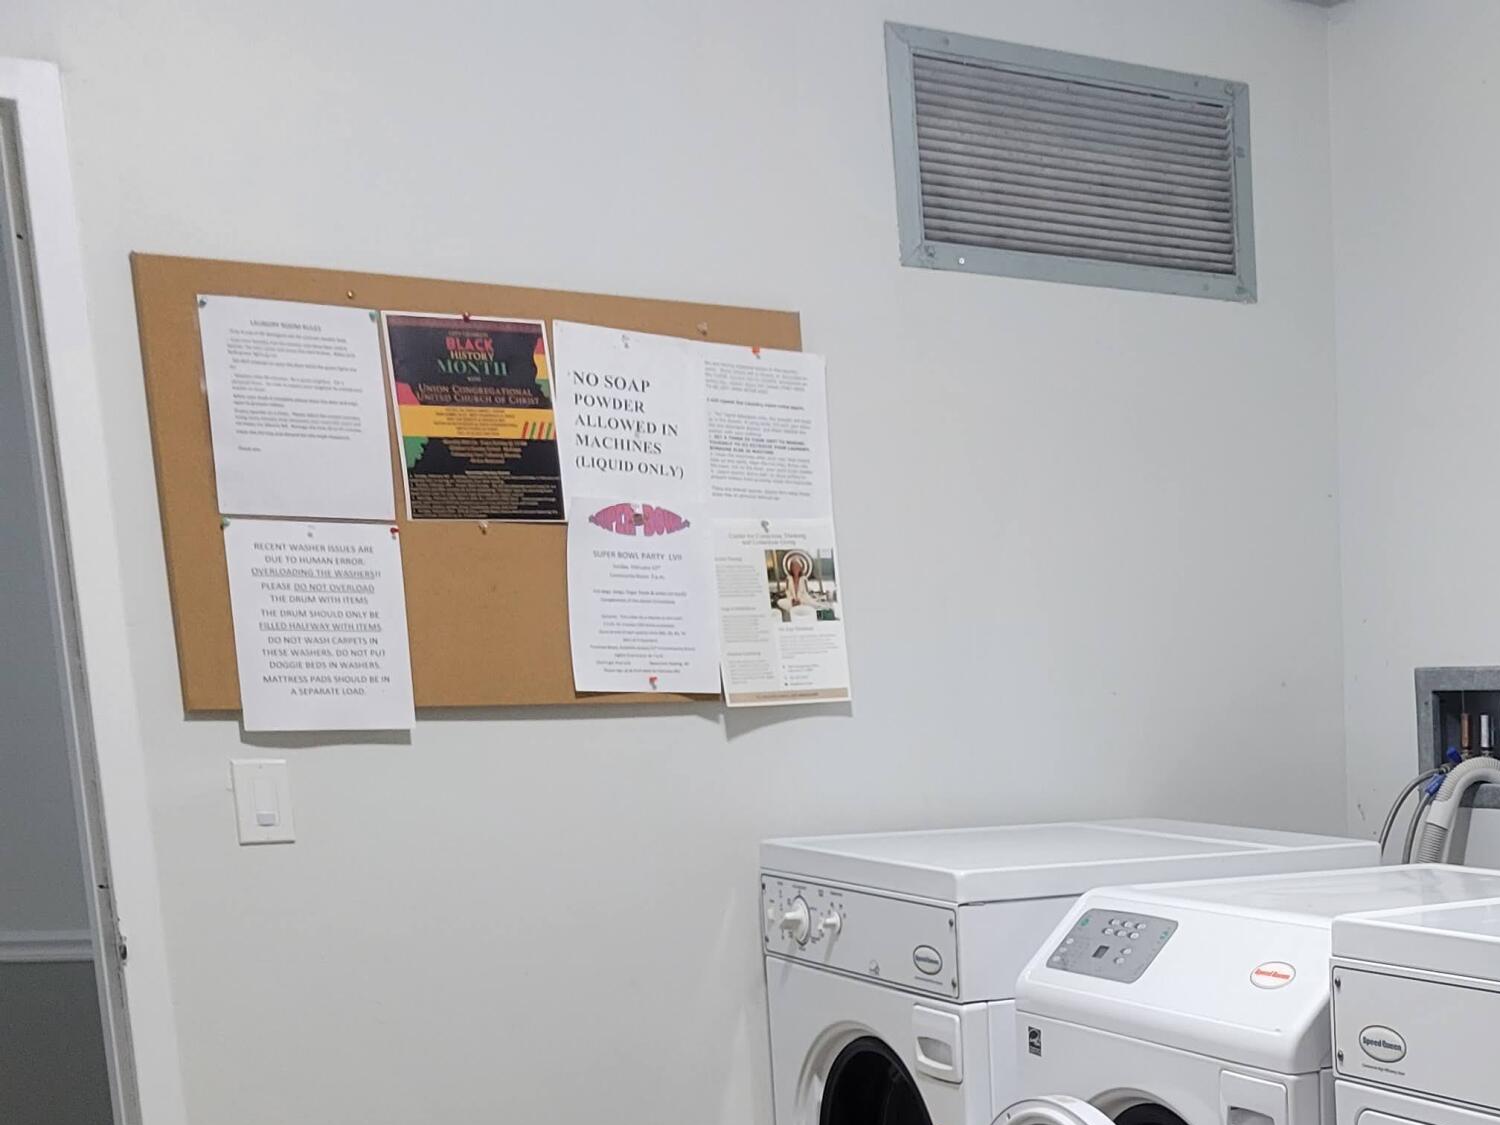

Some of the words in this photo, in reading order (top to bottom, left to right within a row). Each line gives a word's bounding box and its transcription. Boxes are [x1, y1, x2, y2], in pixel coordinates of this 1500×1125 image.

[446, 337, 494, 352] BLACK
[451, 352, 494, 361] HISTORY
[437, 359, 508, 376] MONTH
[573, 371, 598, 386] NO
[604, 375, 650, 392] SOAP
[418, 384, 449, 394] UNION
[452, 385, 533, 396] CONGREGATIONAL
[417, 392, 452, 401] UNITED
[454, 394, 492, 403] CHURCH
[495, 396, 504, 404] OF
[509, 396, 539, 405] CHRIST
[574, 393, 645, 413] POWDER
[575, 415, 656, 434] ALLOWED
[663, 424, 678, 436] IN
[576, 434, 662, 454] MACHINES
[576, 456, 633, 472] (LIQUID
[638, 463, 684, 479] ONLY)
[254, 543, 287, 551] RECENT
[289, 543, 326, 552] WASHER
[328, 545, 356, 553] ISSUES
[358, 545, 374, 553] ARE
[593, 551, 616, 559] SUPER
[618, 552, 639, 560] BOWL
[642, 552, 664, 560] PARTY
[252, 568, 314, 576] OVERLOADING
[316, 569, 331, 577] THE
[310, 584, 326, 592] NOT
[329, 584, 374, 592] OVERLOAD
[280, 610, 307, 618] DRUM
[309, 610, 343, 618] SHOULD
[346, 611, 367, 619] ONLY
[289, 623, 329, 631] HALFWAY
[336, 649, 348, 657] DO
